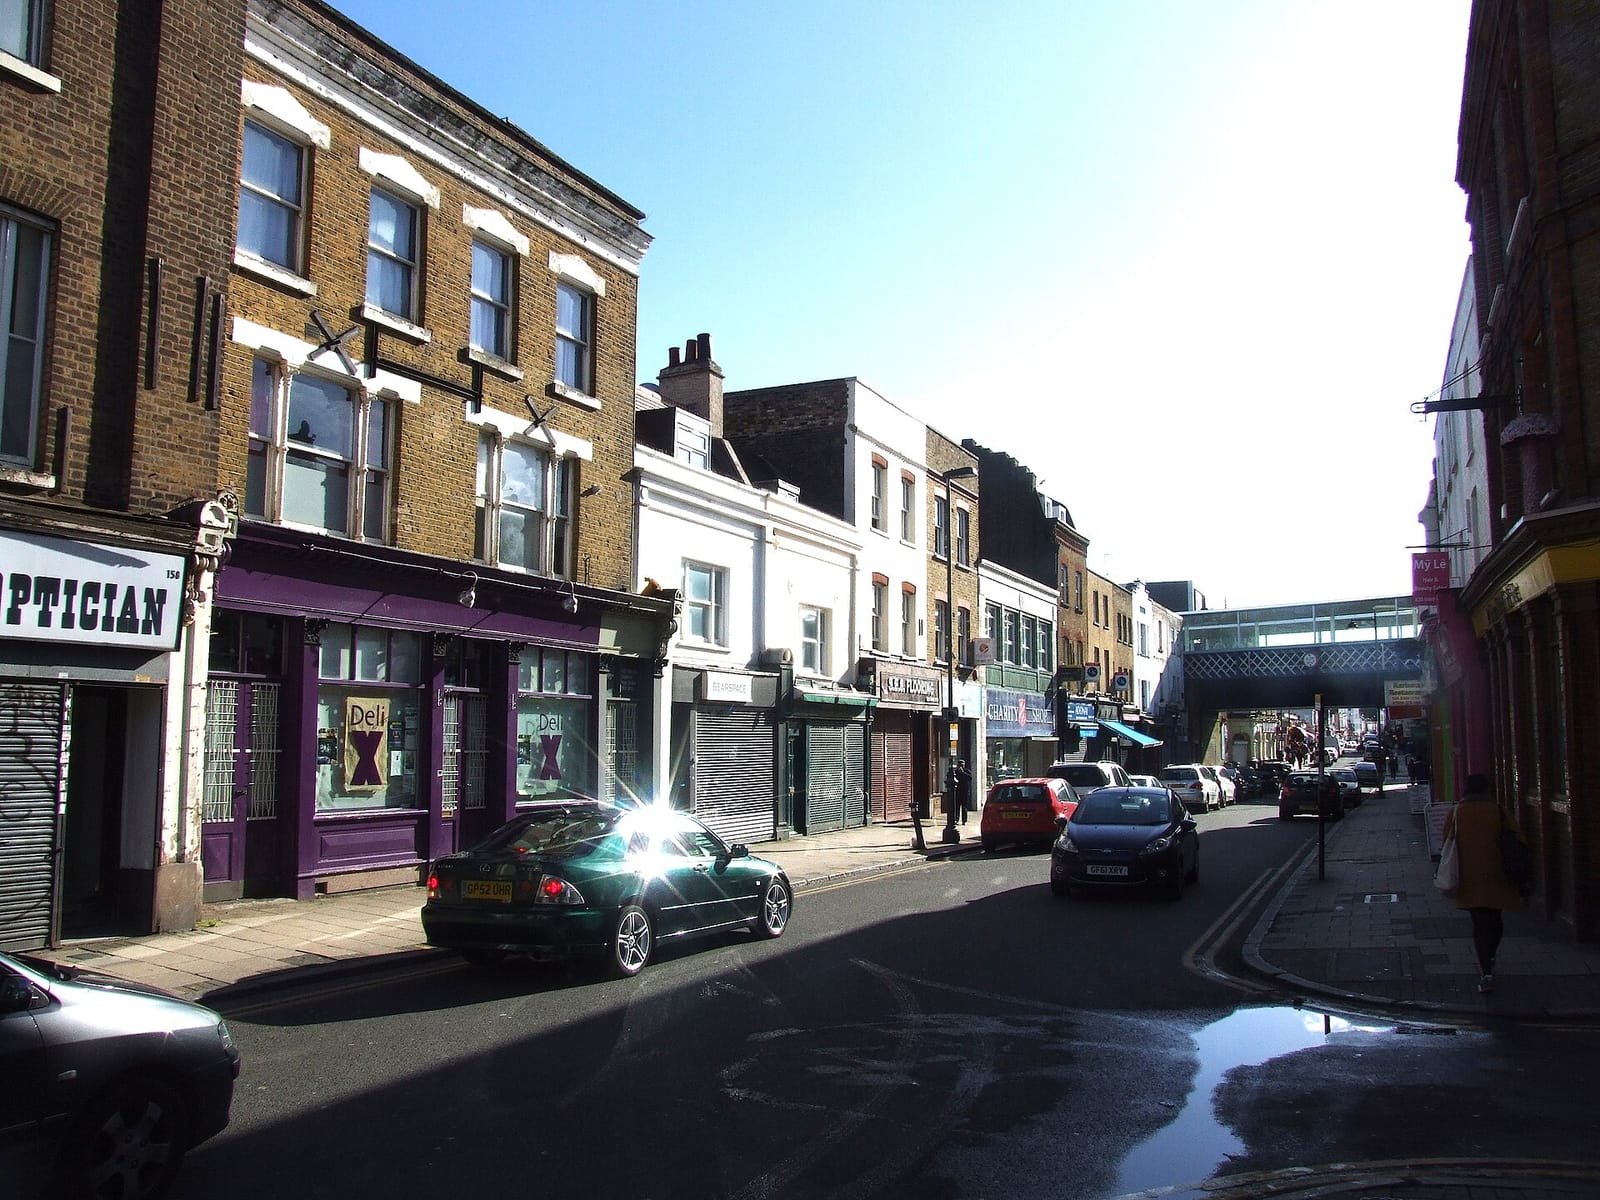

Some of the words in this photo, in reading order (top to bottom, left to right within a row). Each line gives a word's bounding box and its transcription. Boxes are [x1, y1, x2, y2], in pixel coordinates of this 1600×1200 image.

[0, 573, 168, 636] PTICIAN
[712, 681, 747, 694] BEARSPACE
[351, 704, 386, 727] Deli
[540, 713, 564, 731] Deli
[987, 703, 1019, 721] CHARITY
[1032, 708, 1048, 723] SHOP
[349, 730, 385, 786] X
[540, 734, 563, 781] X
[467, 883, 491, 896] GP52
